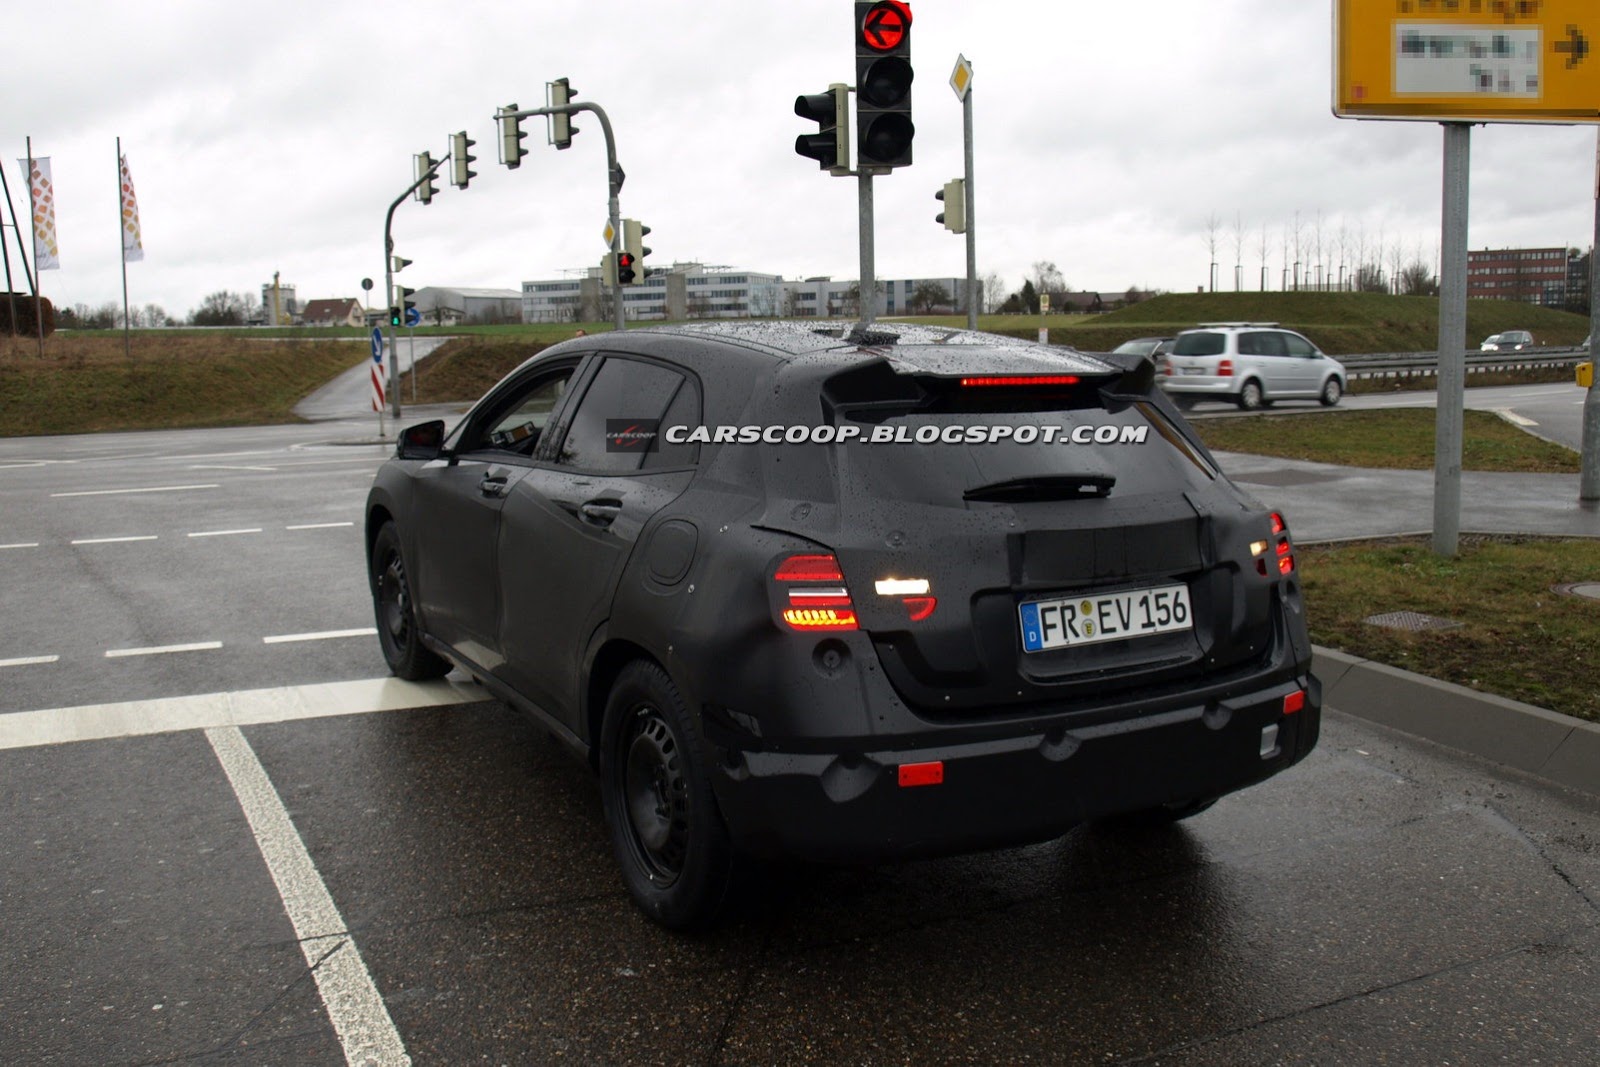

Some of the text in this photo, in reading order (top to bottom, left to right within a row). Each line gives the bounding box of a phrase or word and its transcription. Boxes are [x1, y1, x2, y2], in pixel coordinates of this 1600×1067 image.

[1040, 591, 1187, 642] FR EV 156
[1029, 631, 1037, 642] D
